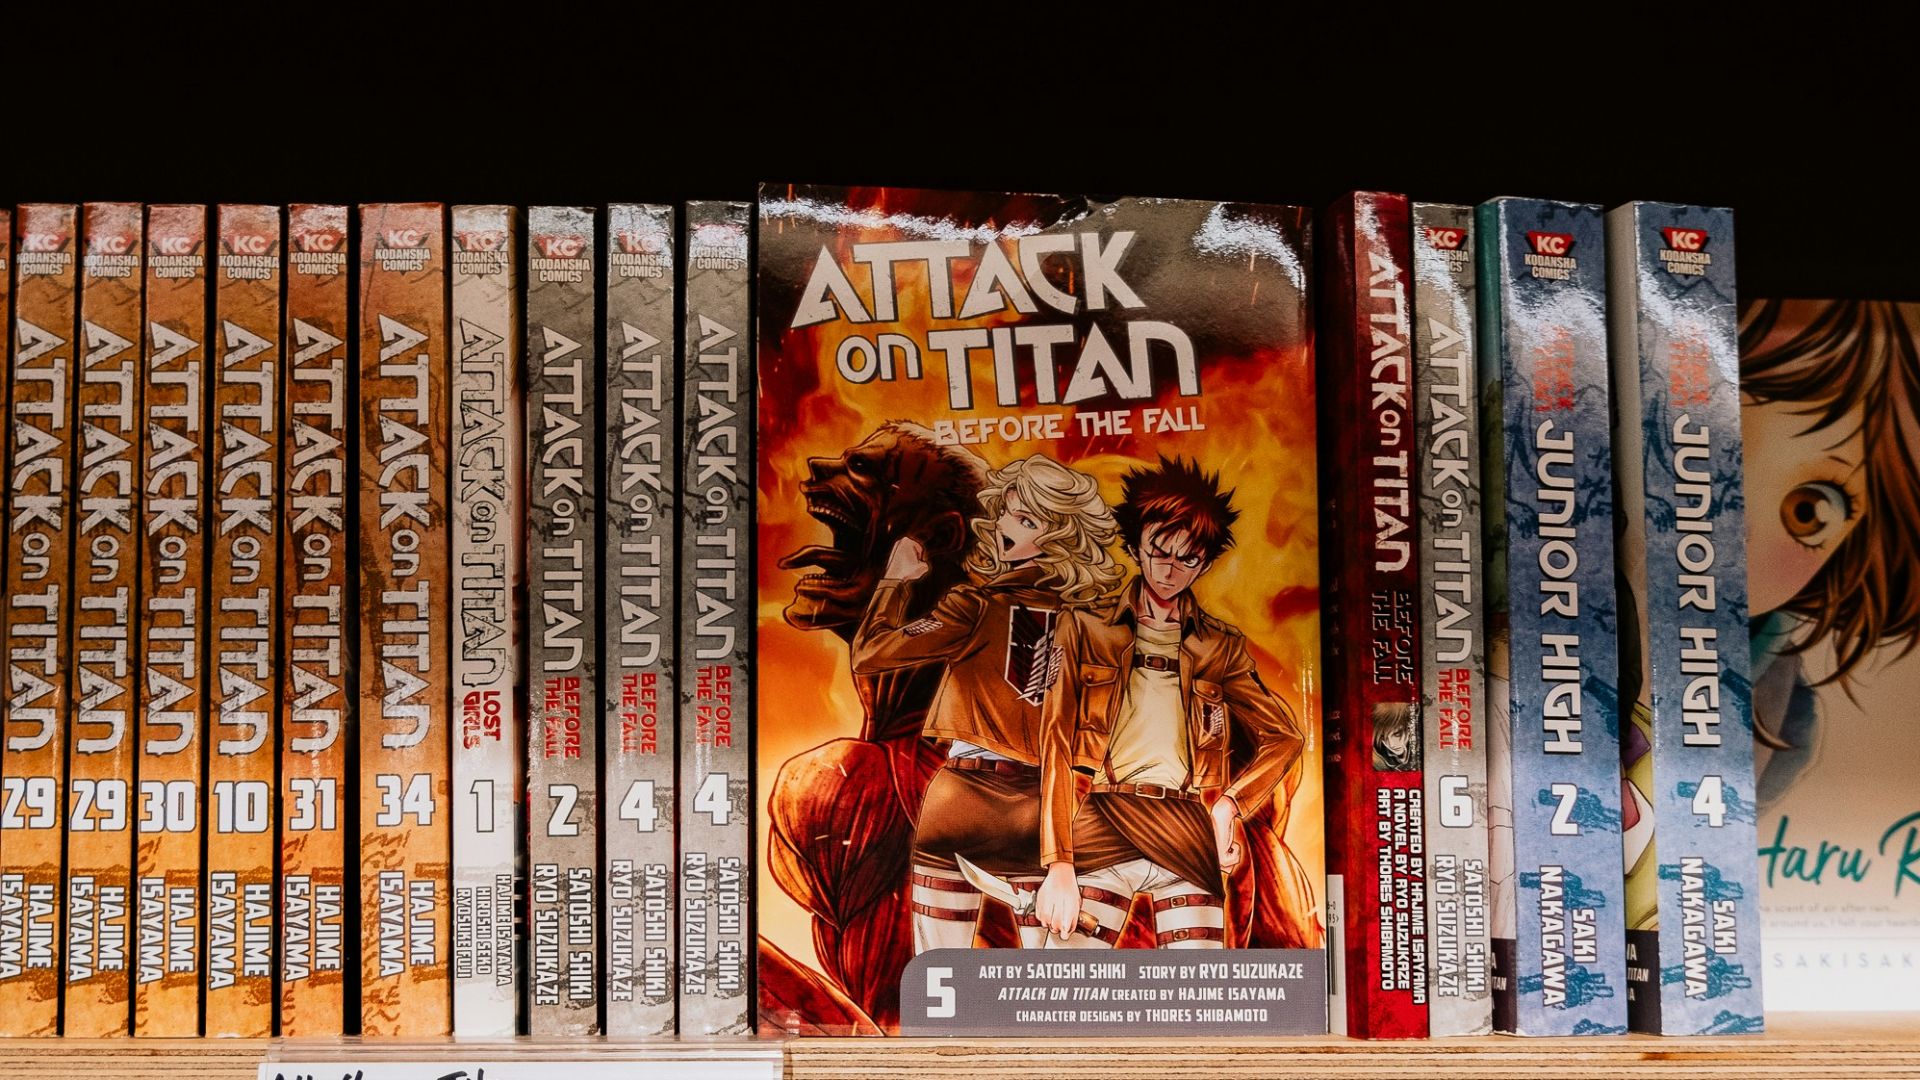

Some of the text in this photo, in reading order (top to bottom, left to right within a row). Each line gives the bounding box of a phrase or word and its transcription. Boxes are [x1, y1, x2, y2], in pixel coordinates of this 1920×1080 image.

[219, 255, 279, 268] KODANSHA
[227, 267, 271, 280] COMICS
[531, 257, 591, 272] KODANSHA
[539, 269, 583, 283] COMICS
[546, 237, 577, 257] KC
[791, 231, 1146, 328] ATTACK
[1524, 253, 1577, 270] KODANSHA
[1531, 266, 1570, 281] COMICS
[1537, 236, 1565, 254] KC
[1660, 249, 1711, 266] KODANSHA
[1667, 261, 1705, 277] COMICS
[1672, 230, 1701, 250] KC
[928, 320, 1199, 410] TITAN
[1428, 317, 1470, 489] ATTACK
[933, 406, 1205, 446] BEFORE THE FALL
[1369, 251, 1412, 573] ATTACK TITAN
[460, 318, 506, 687] ATTACK TITAN
[542, 325, 584, 672] ATTACK TITAN
[620, 320, 661, 668] ATTACK TITAN
[695, 313, 737, 660] ATTACK TITAN
[1536, 418, 1580, 617] JUNIOR
[1672, 412, 1717, 611] JUNIOR
[8, 318, 66, 752] ATTACK TITAN
[77, 319, 135, 754] ATTACK TITAN
[146, 319, 200, 755] ATTACK TITAN
[218, 319, 274, 756] ATTACK TITAN
[290, 317, 344, 754] ATTACK TITAN
[378, 313, 431, 751] ATTACK TITAN
[1372, 590, 1392, 684] THE FALL
[1394, 590, 1413, 684] BEFORE
[1432, 531, 1473, 663] TITAN
[463, 691, 481, 750] GIRLS
[483, 690, 501, 741] LOST
[544, 677, 560, 760] THE FALL
[562, 675, 580, 760] BEFORE
[622, 673, 638, 754] THE FALL
[640, 672, 657, 755] BEFORE
[695, 665, 712, 745] THE FALL
[714, 664, 731, 747] BEFORE
[1437, 669, 1454, 750] THE FALL
[1455, 667, 1471, 751] BEFORE
[1540, 633, 1582, 755] HIGH
[1678, 626, 1722, 747] HIGH
[0, 776, 56, 829] 29
[70, 779, 127, 832] 29
[139, 780, 196, 833] 30
[213, 780, 269, 833] 10
[289, 778, 337, 831] 31
[375, 773, 436, 827] 34
[470, 780, 494, 833] 1
[547, 783, 579, 837] 2
[619, 780, 659, 833] 4
[693, 772, 733, 826] 4
[1439, 775, 1474, 828] 6
[1550, 782, 1580, 836] 2
[1691, 775, 1727, 828] 4
[0, 874, 25, 981] ISAYAMA
[27, 884, 54, 968] HAJIME
[69, 876, 95, 983] ISAYAMA
[98, 886, 125, 971] HAJIME
[138, 877, 166, 985] ISAYAMA
[169, 887, 196, 972] HAJIME
[209, 872, 237, 990] ISAYAMA
[243, 883, 270, 977] HAJIME
[284, 874, 311, 983] ISAYAMA
[315, 884, 342, 972] HAJIME
[379, 870, 405, 978] ISAYAMA
[409, 880, 436, 967] HAJIME
[476, 886, 492, 975] HIROSHI SEKO
[496, 874, 513, 987] HAJIME ISAYAMA
[611, 860, 634, 1002] RYO SUZUKAZE
[645, 864, 667, 997] SATOSHI SHIKI
[685, 852, 707, 995] RYO SUZUKAZE
[718, 857, 740, 990] SATOSHI SHIKI
[1377, 788, 1395, 991] ART BY THORES SHIBAMOTO
[1393, 788, 1411, 991] A NOVEL BY RYO SUZUKAZE
[1408, 788, 1427, 1005] CREATED BY HAJIME ISAYAMA
[1435, 855, 1459, 998] RYO SUZUKAZE
[1463, 859, 1485, 993] SATOSHI SHIKI
[1680, 857, 1707, 997] NAKAGAWA
[1712, 899, 1737, 954] SAKI
[456, 888, 472, 979] RYOSUKE FUJI
[535, 863, 559, 1006] RYO SUZUKAZE
[568, 868, 593, 1001] SATOSHI SHIKI
[979, 964, 1126, 979] ART BY SATOSHI SHIKI
[1139, 964, 1304, 979] STORY BY RYO SUZUKAZE
[1540, 865, 1567, 1006] NAKAGAWA
[1572, 908, 1597, 963] SAKI
[926, 967, 956, 1018] 5
[998, 987, 1286, 1001] ATTACK ON TITAN CREATED BY HAJIME ISAYAMA
[1016, 1008, 1268, 1023] CHARACTER DESIGNS BY THORES SHIBAMOTO
